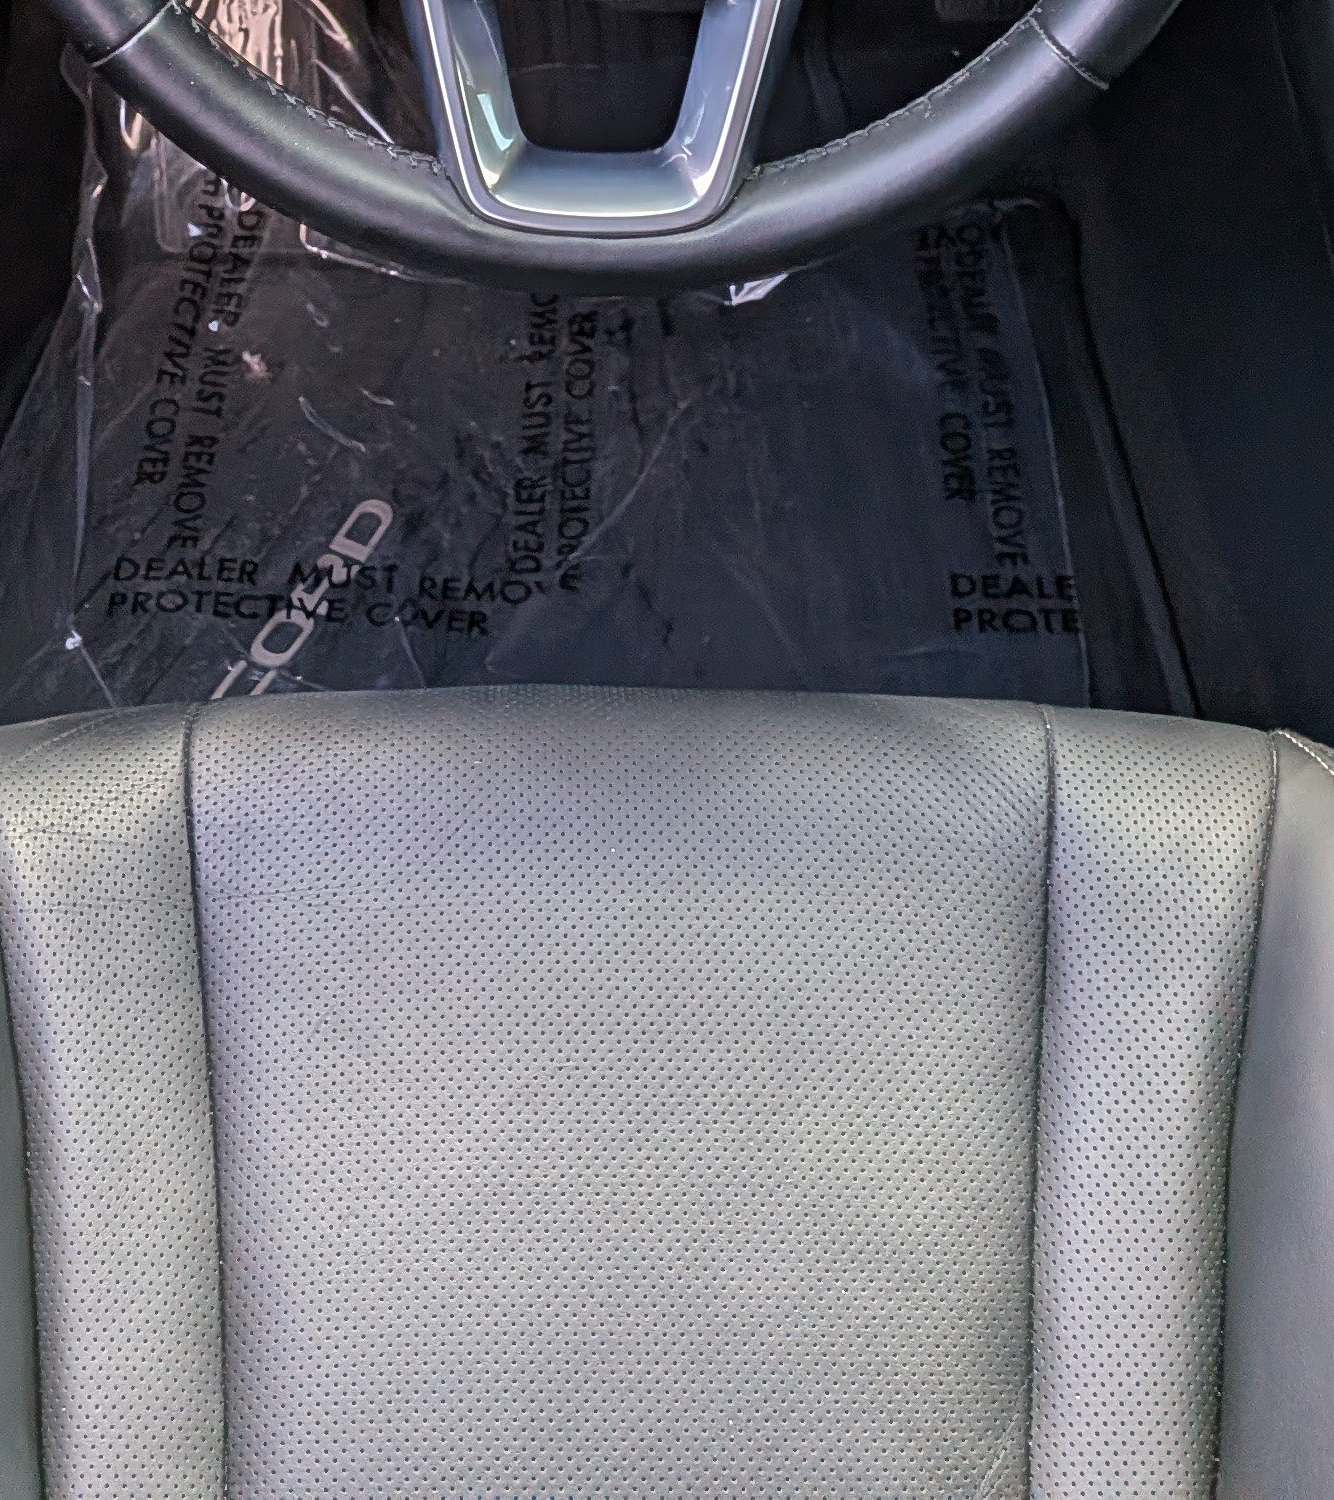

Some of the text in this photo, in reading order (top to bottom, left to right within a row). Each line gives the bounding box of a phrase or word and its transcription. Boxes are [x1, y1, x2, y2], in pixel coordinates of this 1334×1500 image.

[133, 202, 226, 487] PROTECTIVE COVER
[171, 206, 265, 550] DEALER MUST REMOVE
[563, 309, 599, 400] COVER
[519, 380, 553, 458] MUST
[938, 410, 977, 504] COVER
[509, 474, 548, 575] DEALER
[986, 445, 1029, 569] REMOVE
[113, 555, 260, 587] DEALER
[419, 574, 535, 606] REMO
[365, 601, 490, 636] COVER
